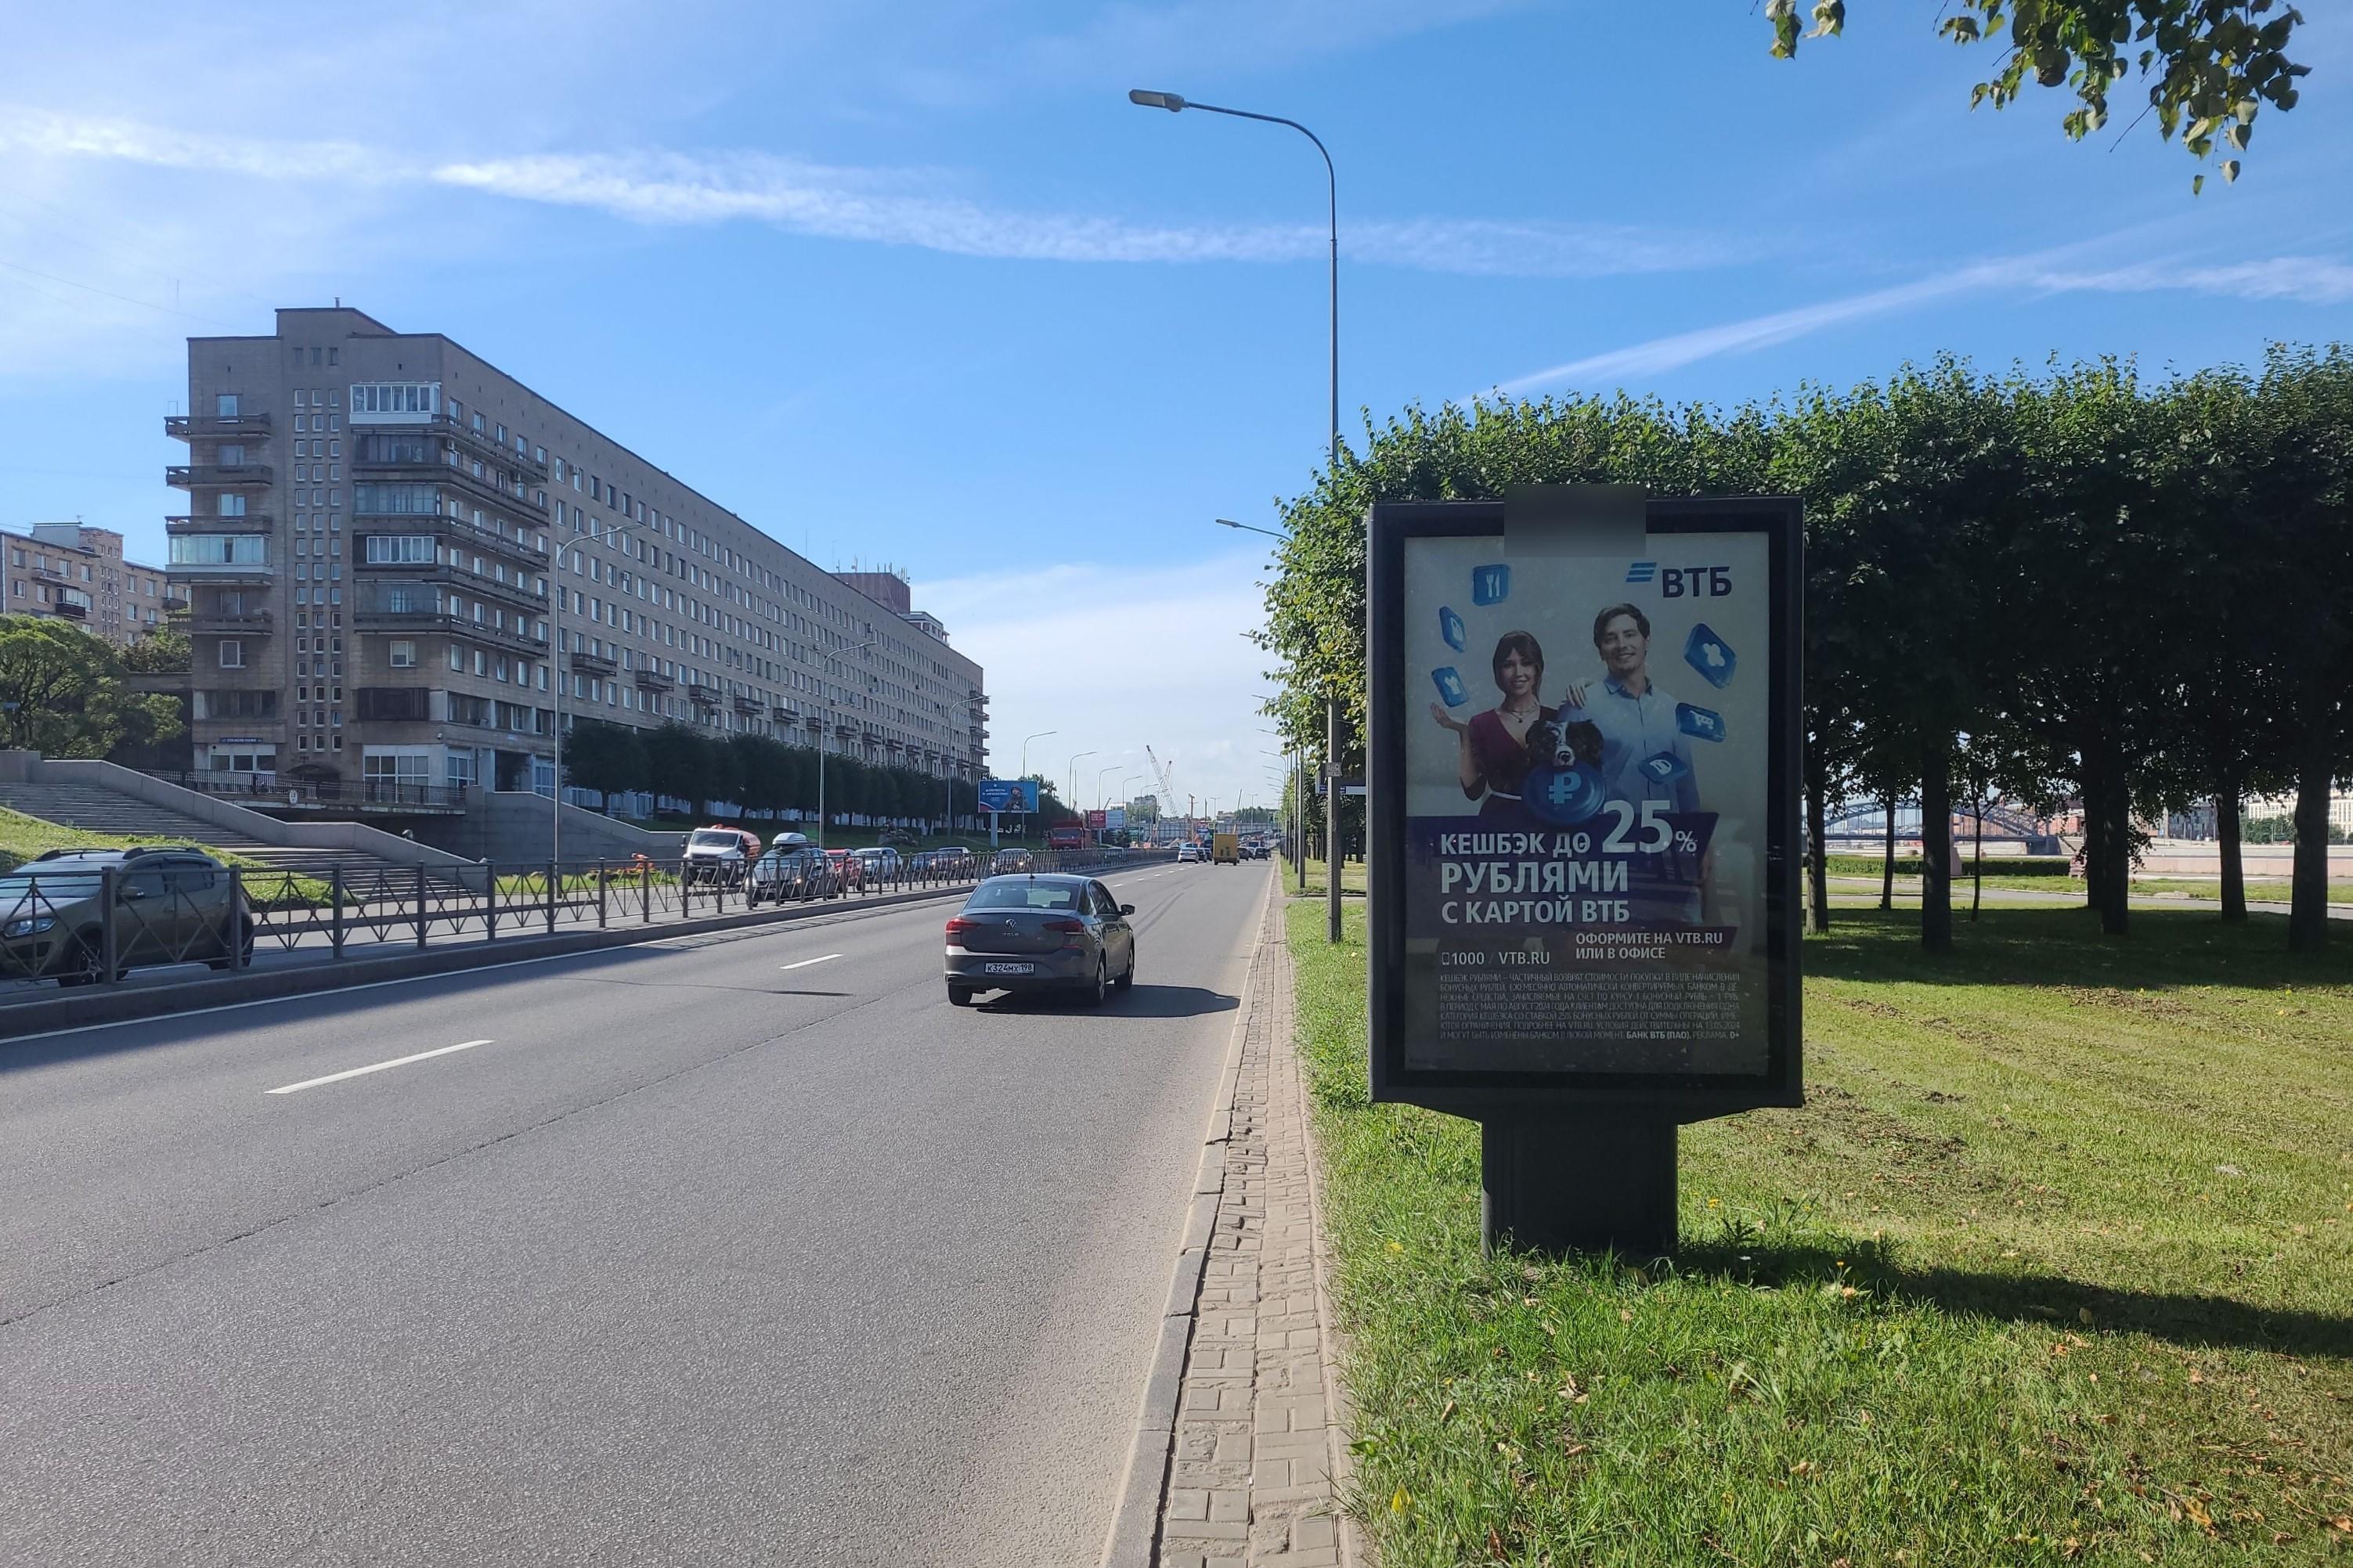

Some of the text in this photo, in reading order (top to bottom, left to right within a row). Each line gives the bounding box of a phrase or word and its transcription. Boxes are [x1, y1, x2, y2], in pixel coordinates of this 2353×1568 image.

[1662, 566, 1733, 599] ВТБ
[1440, 832, 1546, 856] КЕШБЭК
[1552, 831, 1592, 858] ДО
[1440, 860, 1629, 894] РУБЛЯМИ
[1442, 895, 1630, 925] С КАРТОЙ ВТБ
[1575, 932, 1723, 946] ОФОРМИТЕ НА VTB.RU
[1451, 951, 1485, 966] 1000
[1498, 951, 1550, 966] VTB.RU
[1575, 946, 1666, 960] ИЛИ В ОФИСЕ
[1440, 974, 1467, 982] КЕШБЭК
[1470, 974, 1501, 982] РУБЛЯМИ
[1510, 973, 1552, 982] ЧАСТИЧНЫЙ
[1554, 973, 1583, 982] ВОЗВРАТ
[1584, 973, 1629, 982] СТОИМОСТИ
[1630, 973, 1664, 982] ПОКУПКИ
[1666, 972, 1671, 982] В
[1692, 972, 1740, 982] НАЧИСЛЕНИЯ
[1440, 983, 1478, 992] БОНУСНЫХ
[1558, 983, 1618, 992] АВТОМАТИЧЕСКИ
[1620, 982, 1684, 991] КОНВЕРТИРУЕМЫХ
[1687, 982, 1718, 991] БАНКОМ
[1720, 982, 1726, 991] В
[1564, 993, 1575, 1002] НА
[1597, 993, 1608, 1001] ПО
[1610, 993, 1633, 1001] КУРСУ
[1481, 1003, 1496, 1011] МАЯ
[1626, 1031, 1649, 1040] БАНК
[1650, 1031, 1666, 1040] ВТБ
[1730, 1031, 1741, 1040] 0+
